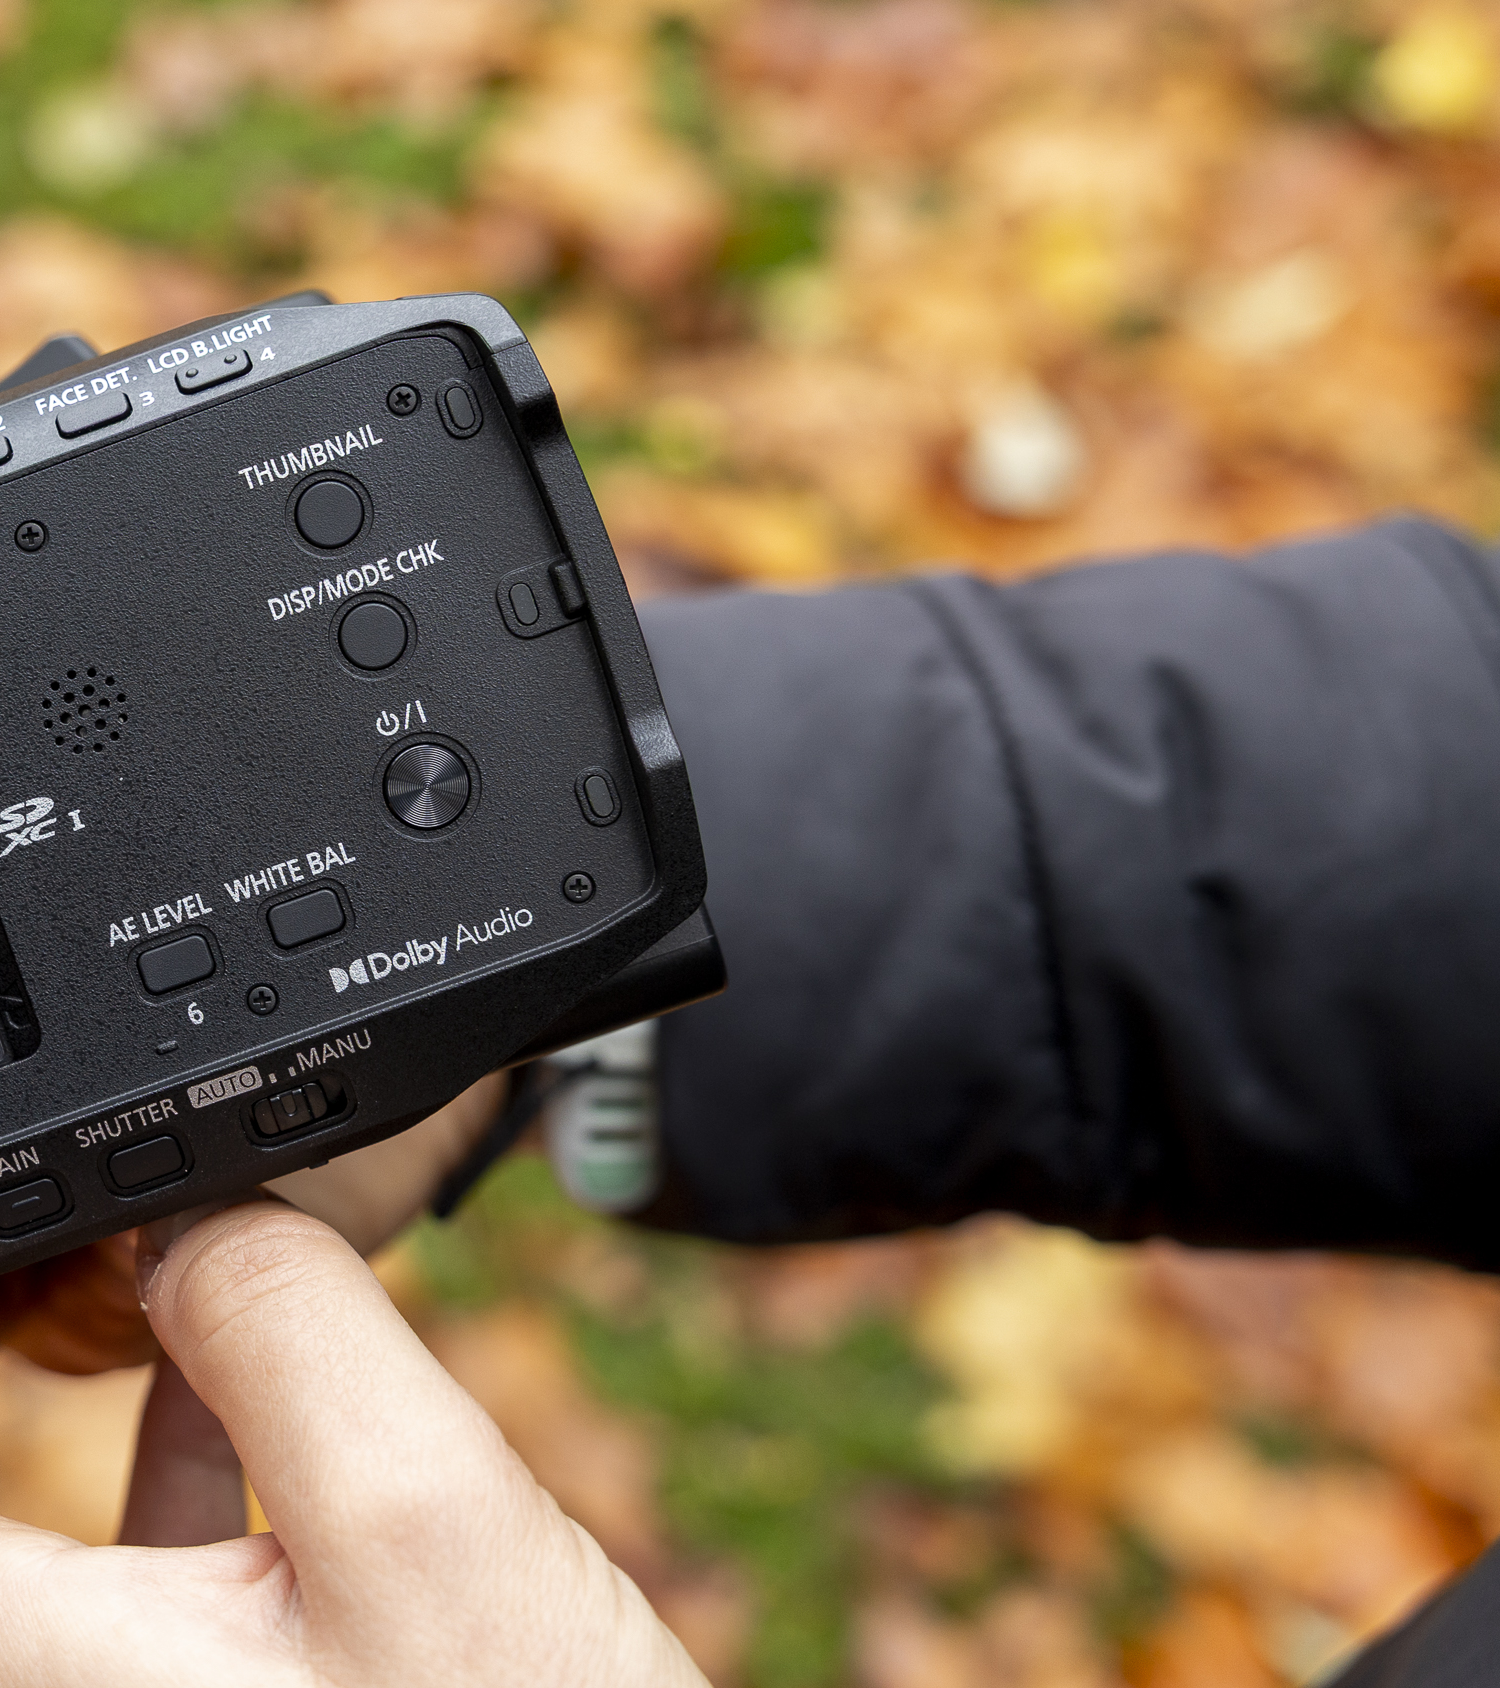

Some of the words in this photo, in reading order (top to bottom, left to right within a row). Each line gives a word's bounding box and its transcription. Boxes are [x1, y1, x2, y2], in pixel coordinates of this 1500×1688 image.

[147, 347, 190, 375] LCD
[192, 314, 277, 359] B.LIGHT
[260, 346, 276, 362] 4
[34, 385, 89, 416] FACE
[90, 366, 139, 396] DET.
[138, 390, 156, 407] 3
[237, 423, 384, 490] THUMBNAIL
[267, 557, 392, 622] DISP/MODE
[396, 539, 445, 574] CHK
[223, 858, 305, 903] WHITE
[308, 842, 357, 876] BAL
[108, 918, 140, 948] AE
[141, 892, 213, 934] LEVEL
[368, 935, 449, 981] Dolby
[455, 906, 534, 952] Audio
[186, 1001, 205, 1025] 6
[295, 1028, 372, 1074] MANU
[194, 1069, 258, 1104] AUTO
[74, 1097, 179, 1150] SHUTTER
